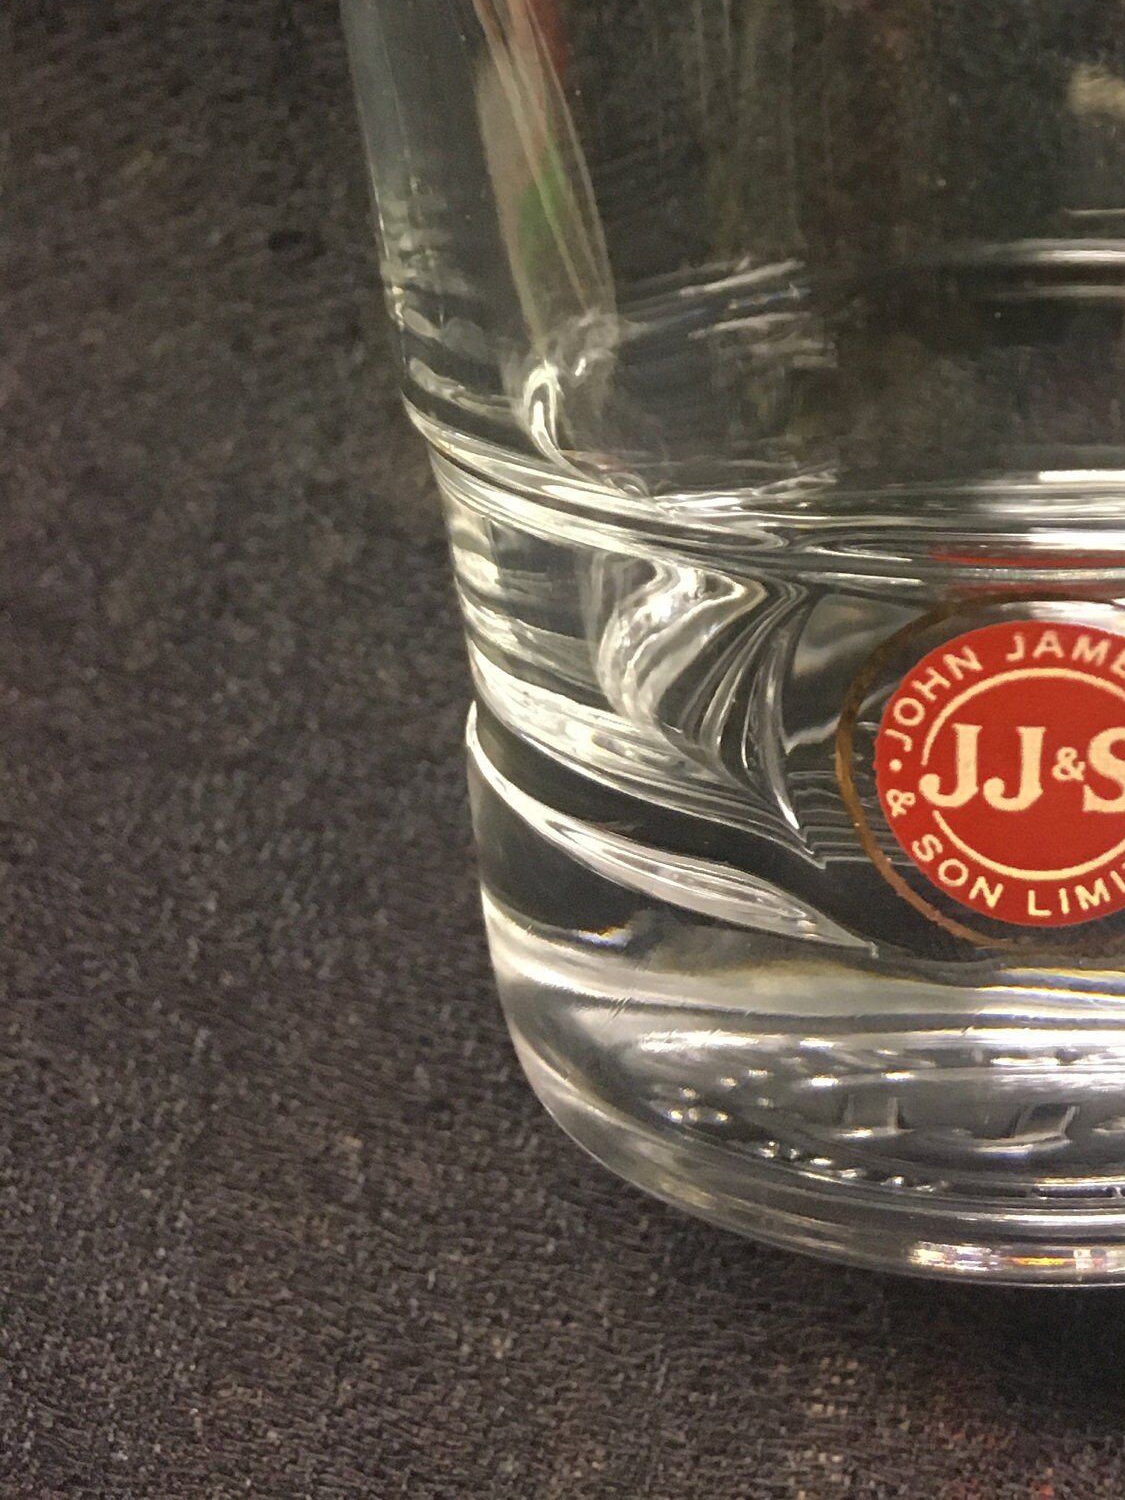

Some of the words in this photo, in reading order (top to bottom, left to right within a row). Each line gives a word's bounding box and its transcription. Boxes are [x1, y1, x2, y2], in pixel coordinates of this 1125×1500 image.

[884, 645, 984, 753] JOHN
[885, 787, 918, 818] &
[911, 832, 1004, 910] SON
